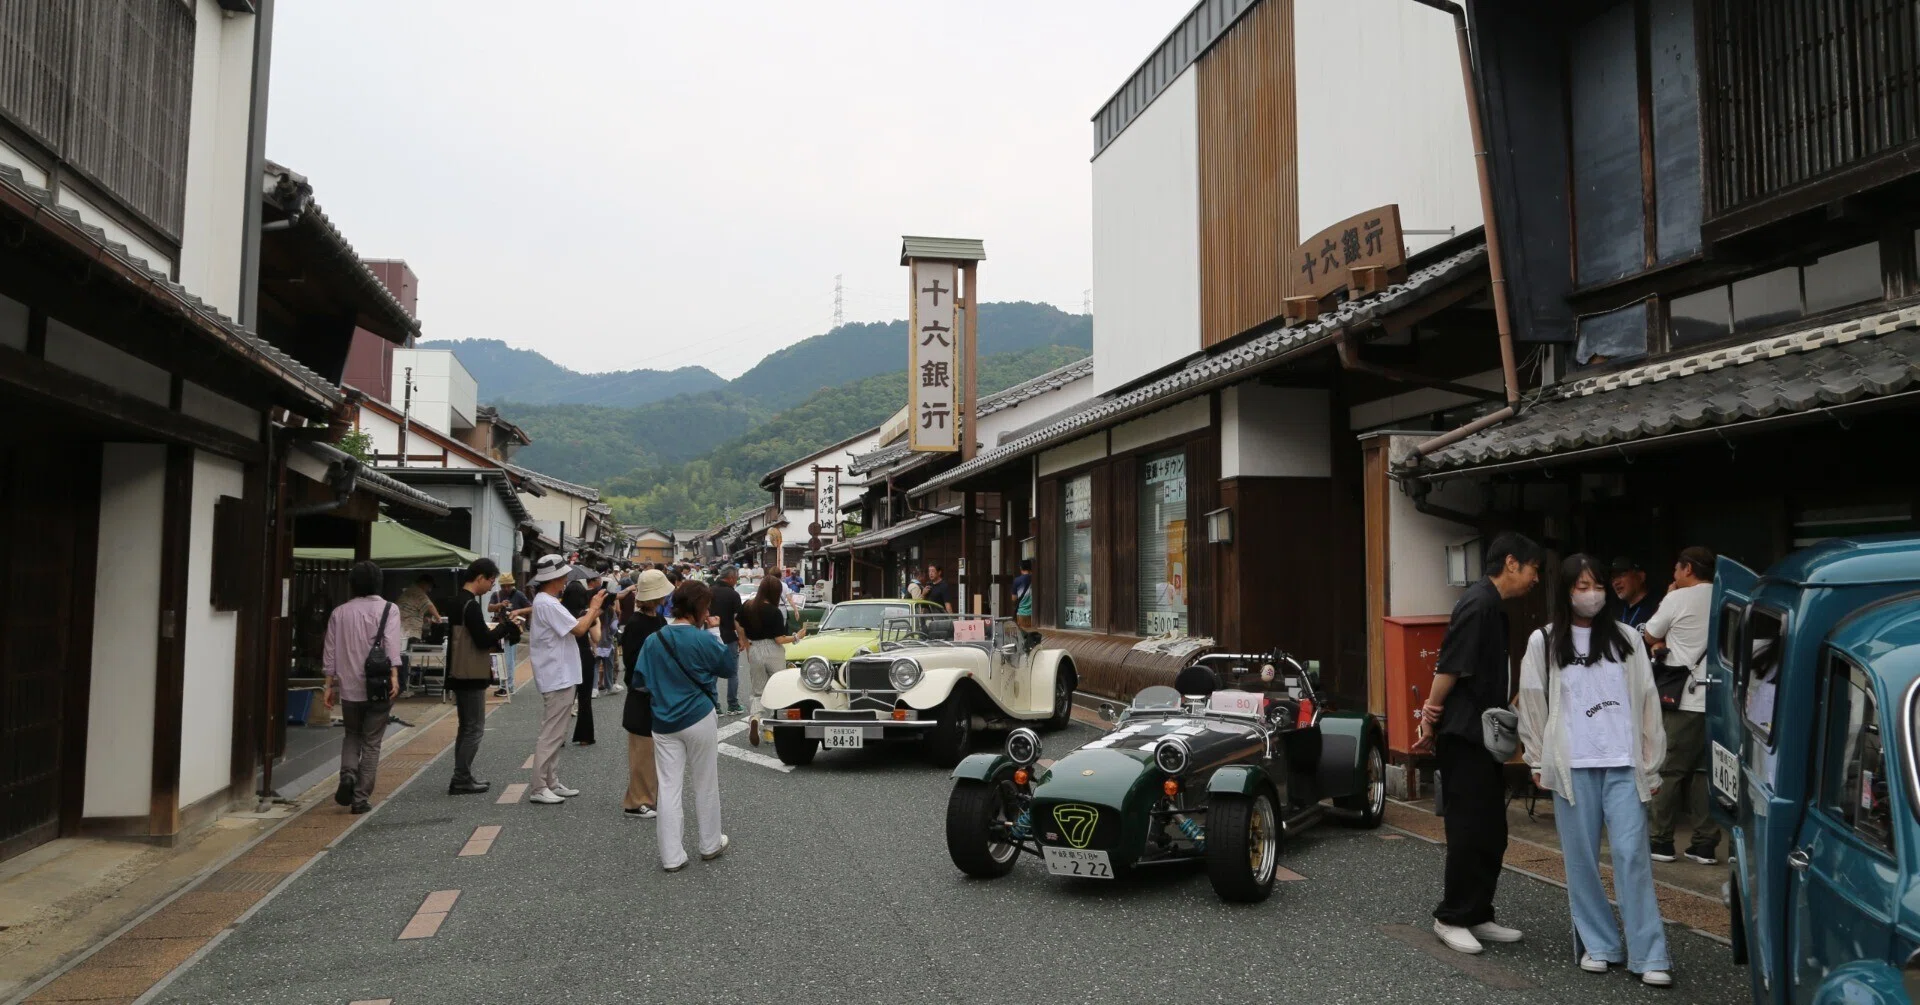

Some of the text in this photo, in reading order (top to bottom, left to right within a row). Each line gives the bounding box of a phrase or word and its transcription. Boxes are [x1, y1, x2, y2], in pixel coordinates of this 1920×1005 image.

[1301, 218, 1384, 285] 十六銀行
[921, 279, 950, 429] 十六銀行
[820, 519, 834, 529] 山水
[1236, 699, 1250, 709] 80
[832, 735, 860, 747] 84-81
[1719, 765, 1737, 799] 40-8
